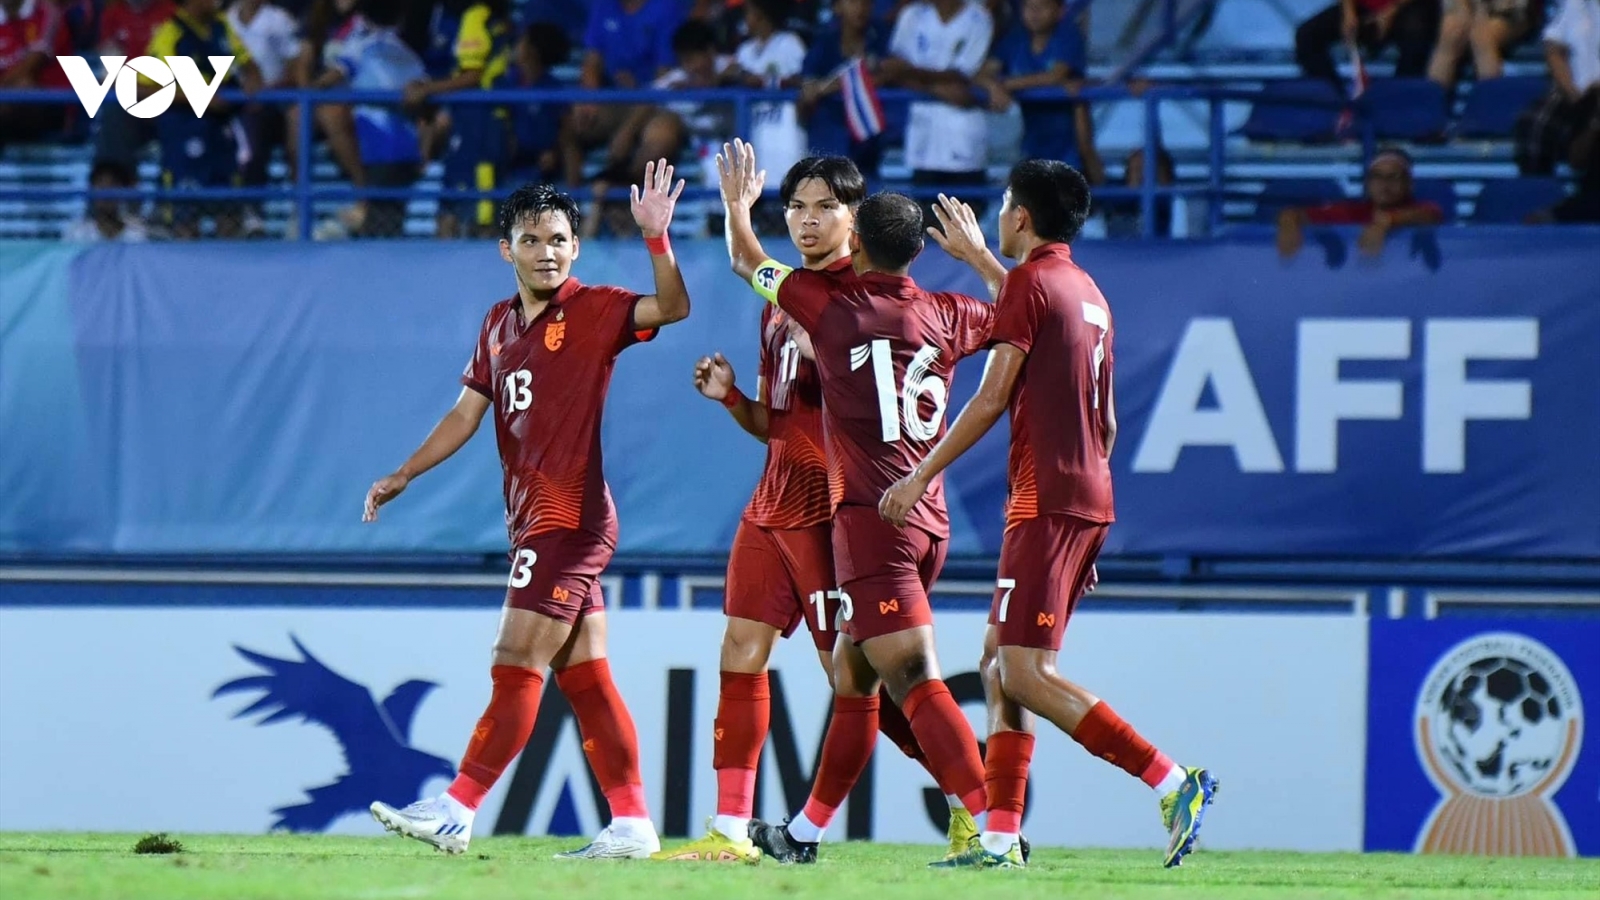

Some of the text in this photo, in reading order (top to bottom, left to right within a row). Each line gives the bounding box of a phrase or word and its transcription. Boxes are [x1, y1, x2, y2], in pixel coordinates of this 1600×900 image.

[504, 369, 534, 414] 13
[850, 338, 947, 442] 16
[1082, 301, 1108, 410] 7
[1132, 317, 1540, 474] AFF
[809, 590, 842, 631] 17
[997, 578, 1016, 623] 7
